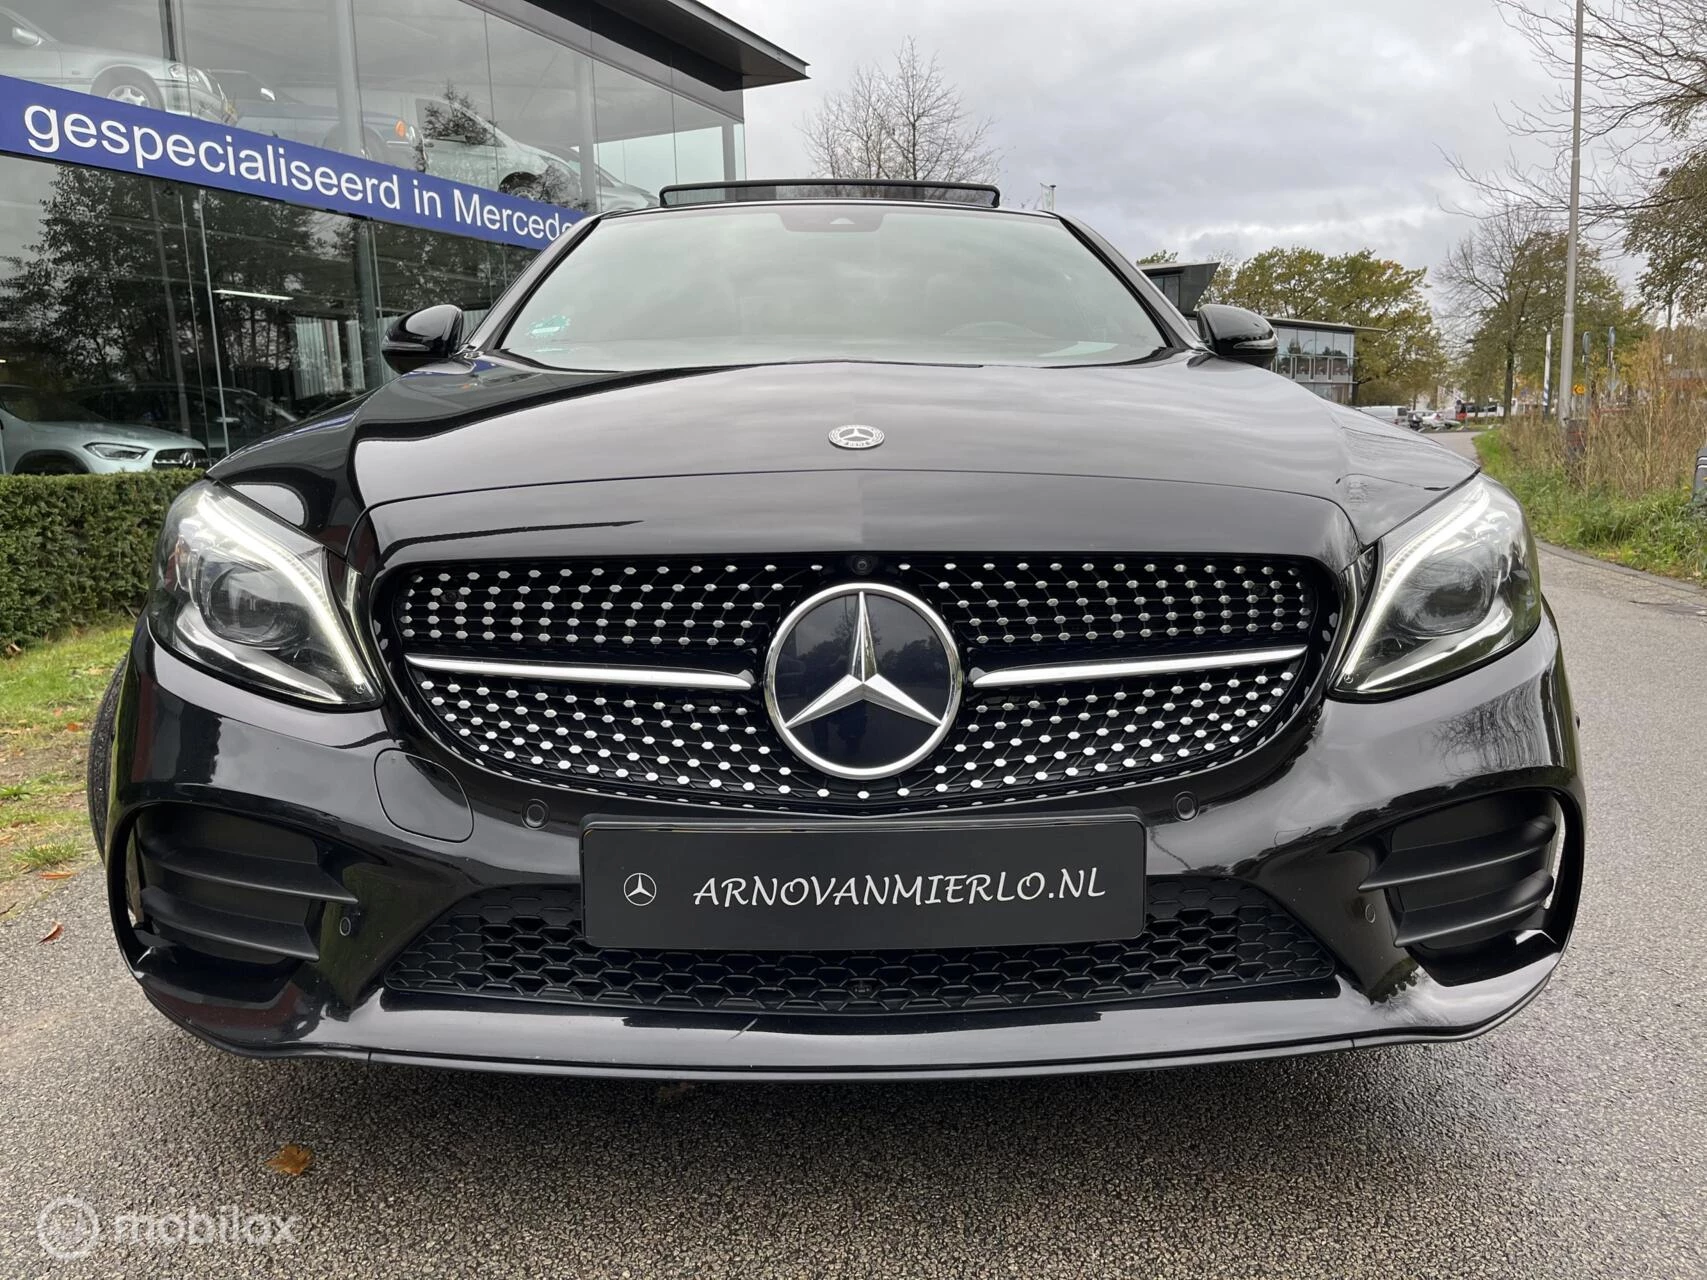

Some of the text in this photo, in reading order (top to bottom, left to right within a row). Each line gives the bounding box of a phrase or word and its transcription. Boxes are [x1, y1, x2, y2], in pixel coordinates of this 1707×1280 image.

[24, 105, 401, 210] gespecialiseerd
[412, 179, 442, 219] in
[693, 867, 1106, 908] ARNOVANMIERLO.NL
